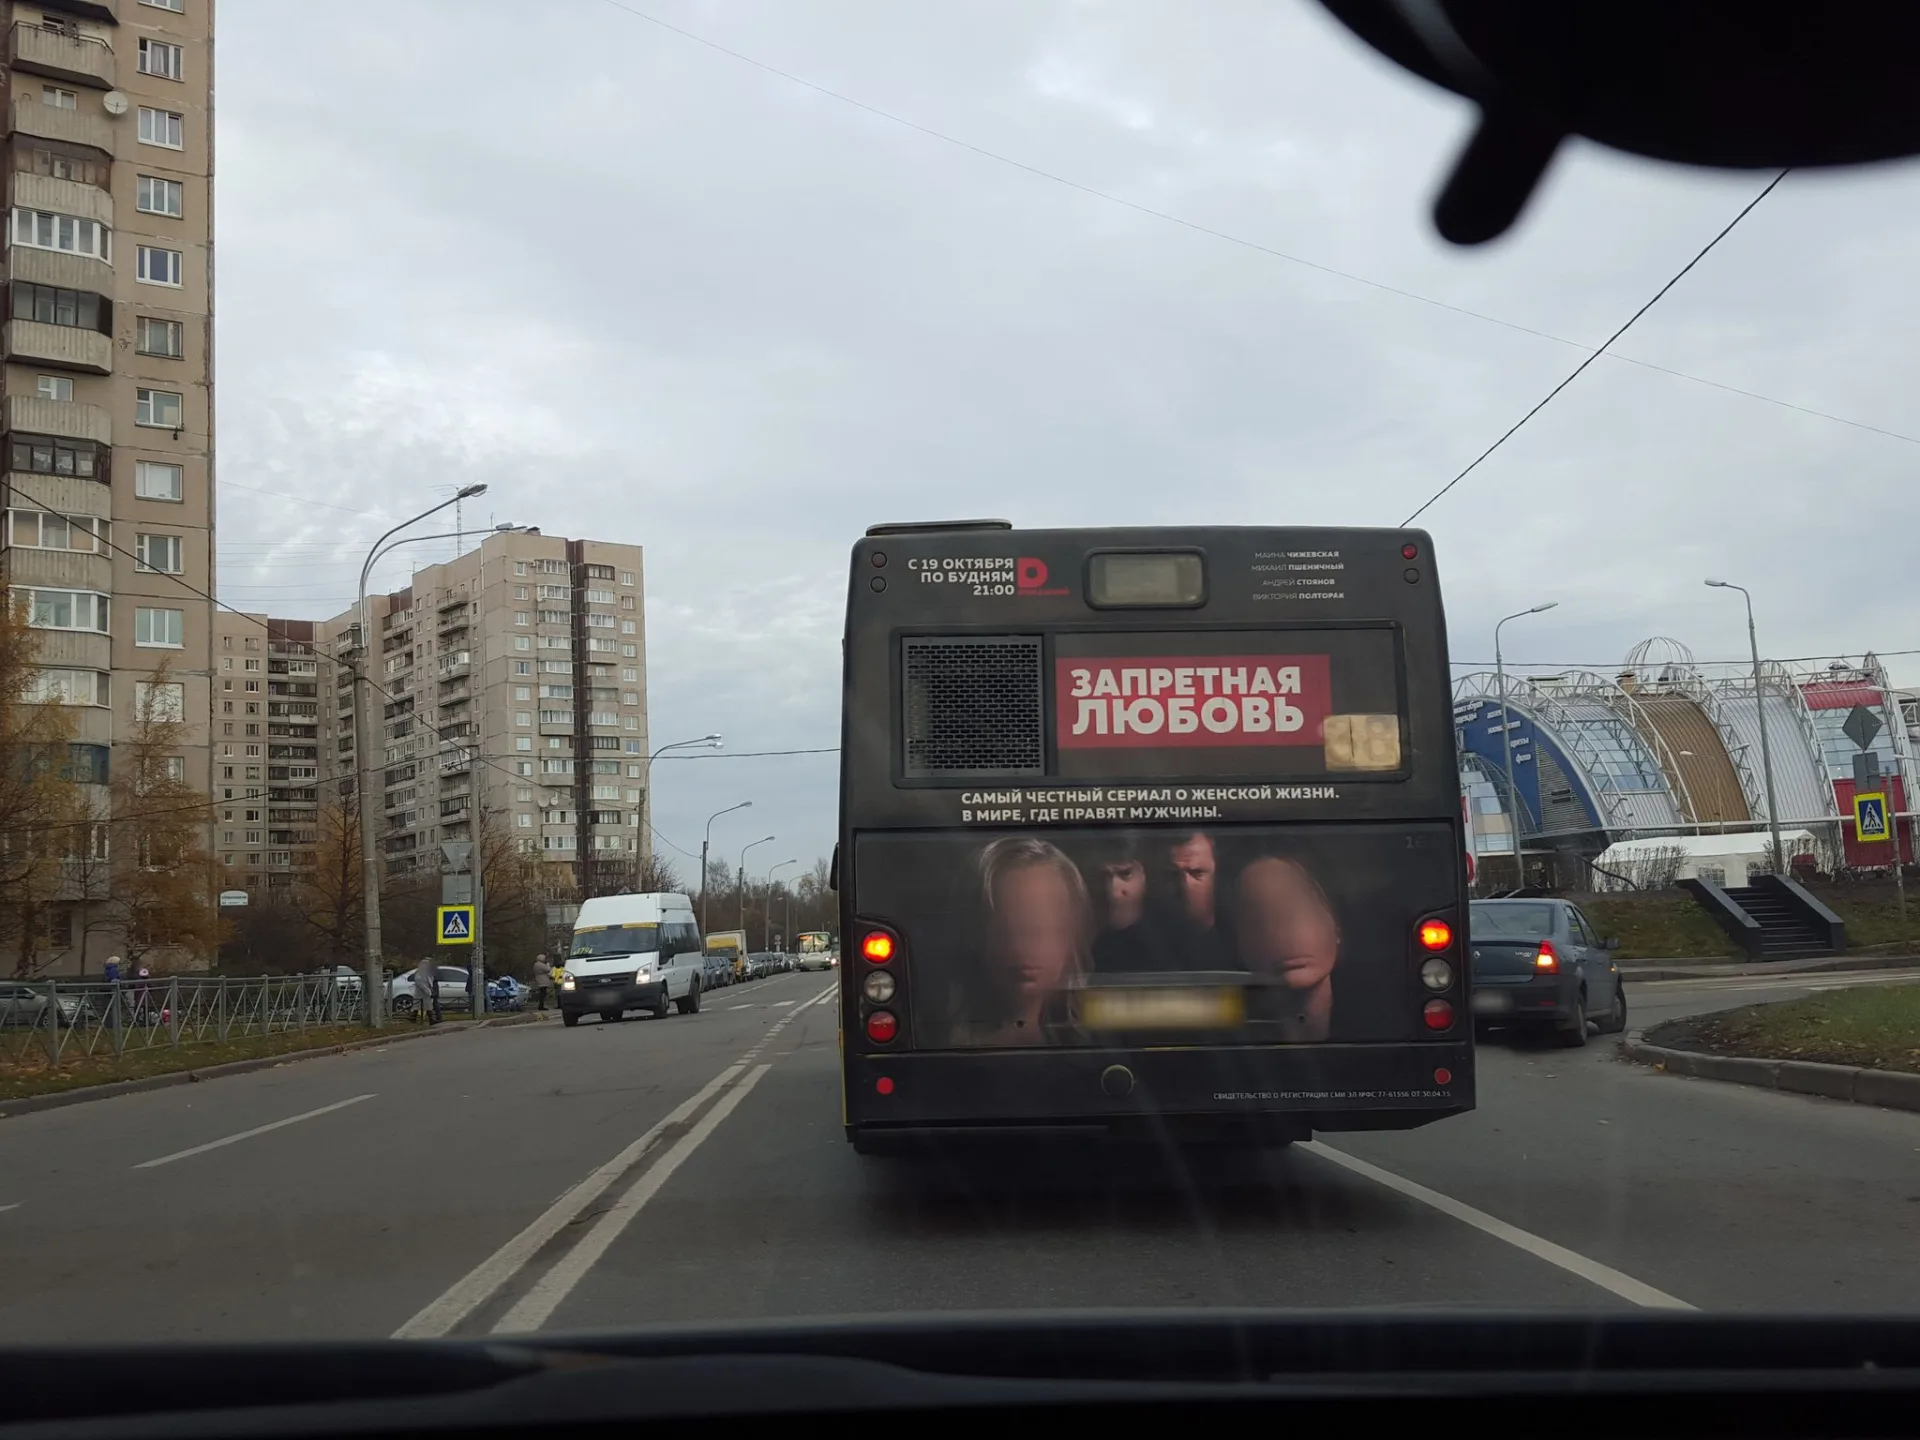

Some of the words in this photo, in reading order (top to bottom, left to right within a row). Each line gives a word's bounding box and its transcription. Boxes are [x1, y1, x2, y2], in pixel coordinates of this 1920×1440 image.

[908, 559, 918, 570] С
[921, 559, 938, 569] 19
[942, 558, 1014, 569] ОКТЯБРЯ
[1288, 562, 1344, 570] ПШЕНИЧНЫЙ
[921, 572, 944, 583] ПО
[948, 571, 1014, 584] БУДНЯМ
[1262, 578, 1296, 587] АНДРЕЙ
[973, 585, 1015, 596] 21:00
[1070, 666, 1302, 697] ЗАПРЕТНАЯ
[1072, 697, 1304, 735] ЛЮБОВЬ
[961, 789, 1022, 804] САМЫЙ
[1026, 787, 1103, 803] ЧЕСТНЫЙ
[1107, 789, 1171, 801] СЕРИАЛ
[1175, 789, 1188, 800] О
[1191, 785, 1272, 800] ЖЕНСКОЙ
[1275, 787, 1340, 799] ЖИЗНИ.
[962, 809, 972, 821] В
[976, 809, 1026, 822] МИРЕ,
[1030, 808, 1059, 822] ГДЕ
[1063, 807, 1126, 820] ПРАВЯТ
[1129, 806, 1222, 819] МУЖЧИНЫ.
[1213, 1092, 1272, 1100] СВИДЕТЕЛЬСТВО
[1281, 1091, 1329, 1099] РЕГИСТРАЦИИ
